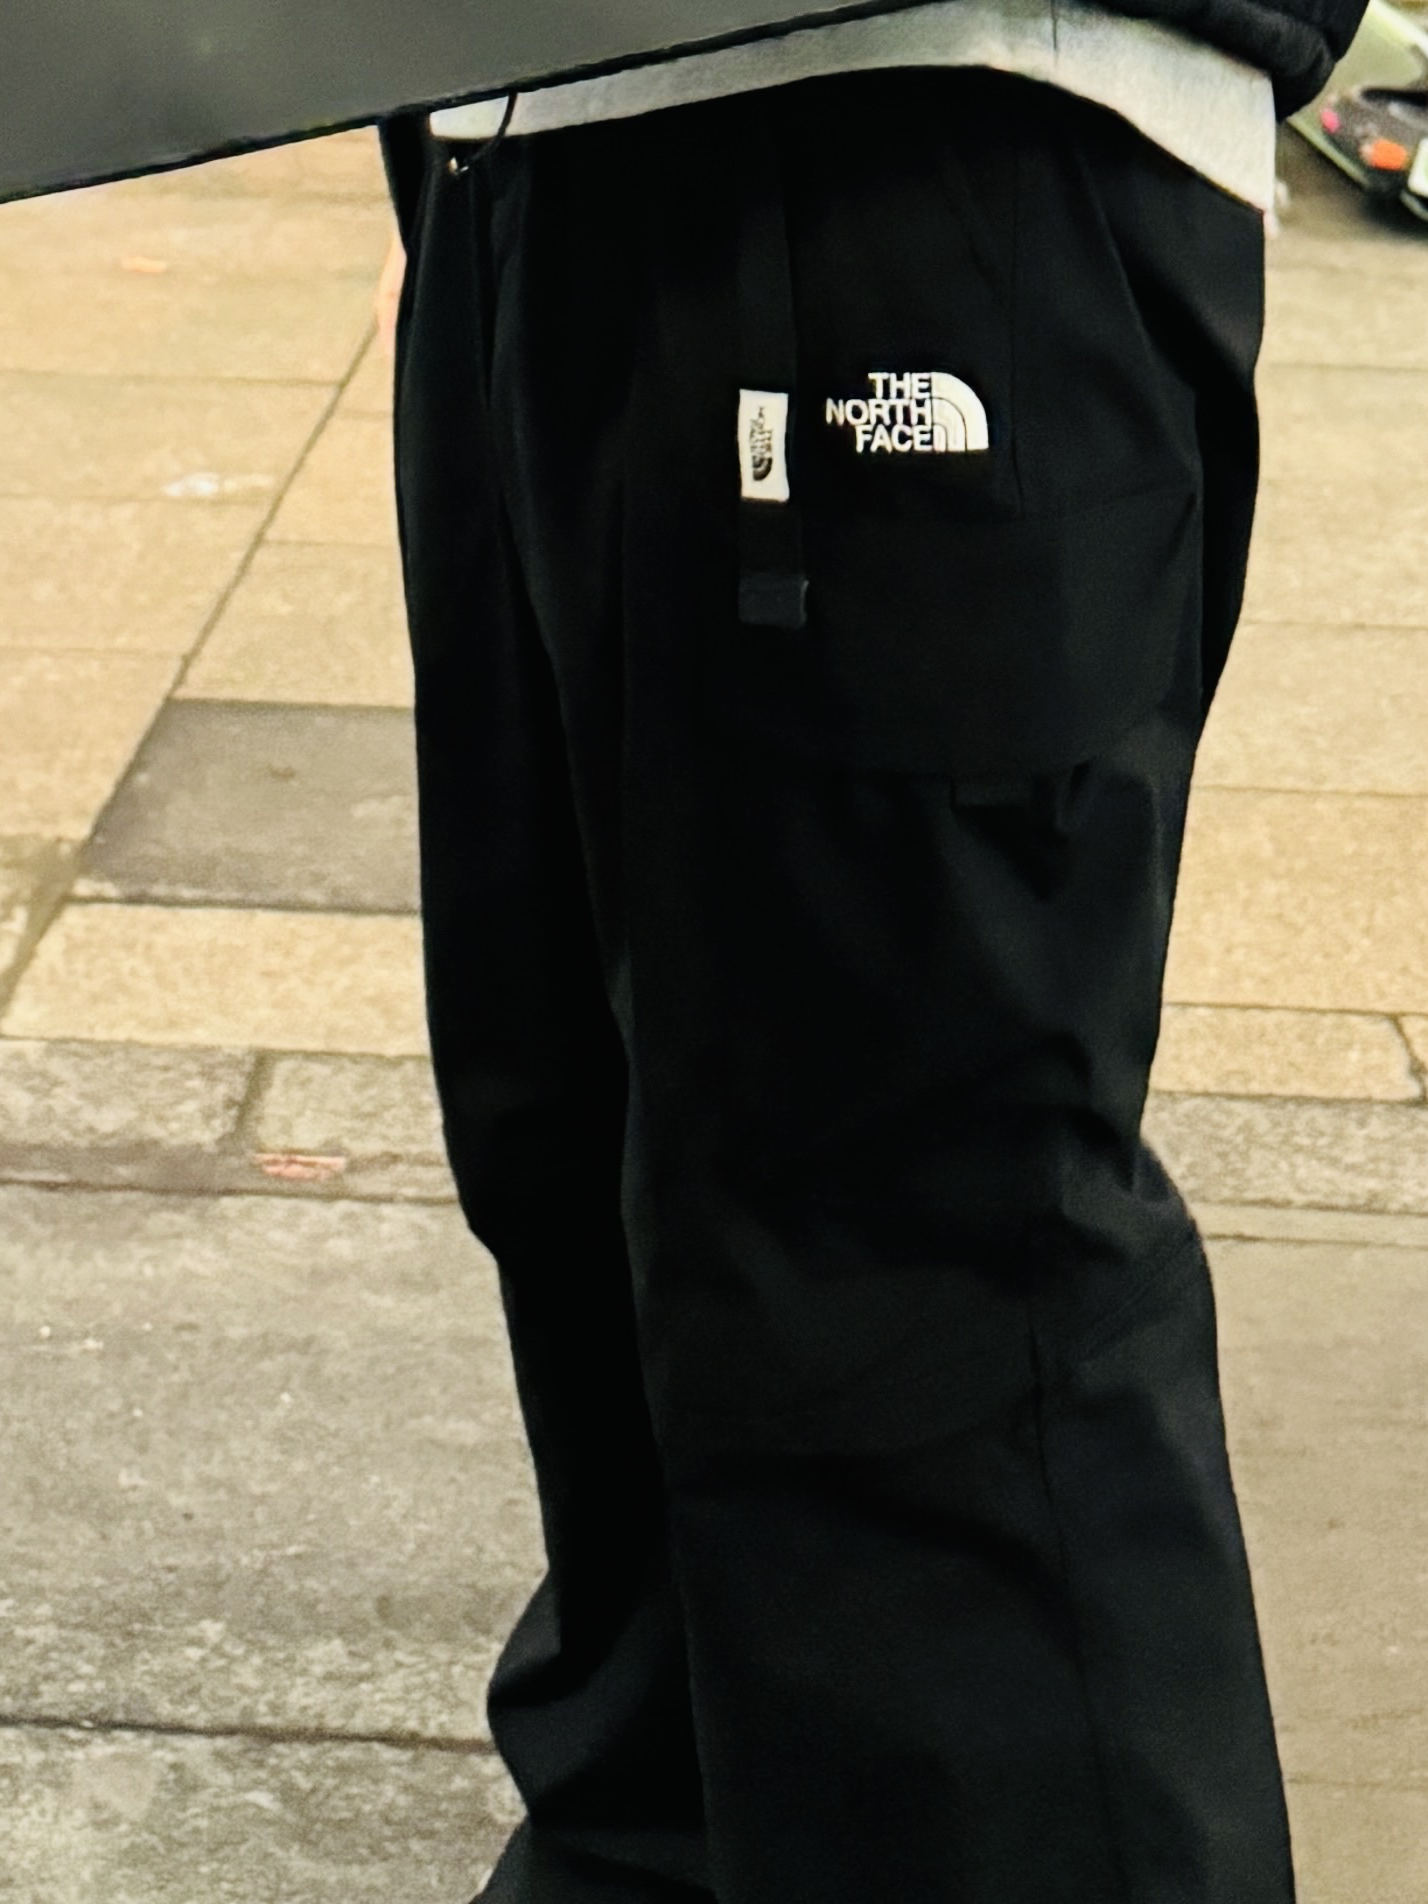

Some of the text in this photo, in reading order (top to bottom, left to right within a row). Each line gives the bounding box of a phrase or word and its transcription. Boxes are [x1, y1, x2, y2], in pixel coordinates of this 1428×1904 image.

[868, 372, 931, 399] THE
[826, 398, 932, 425] NORTH
[856, 424, 933, 453] FACE
